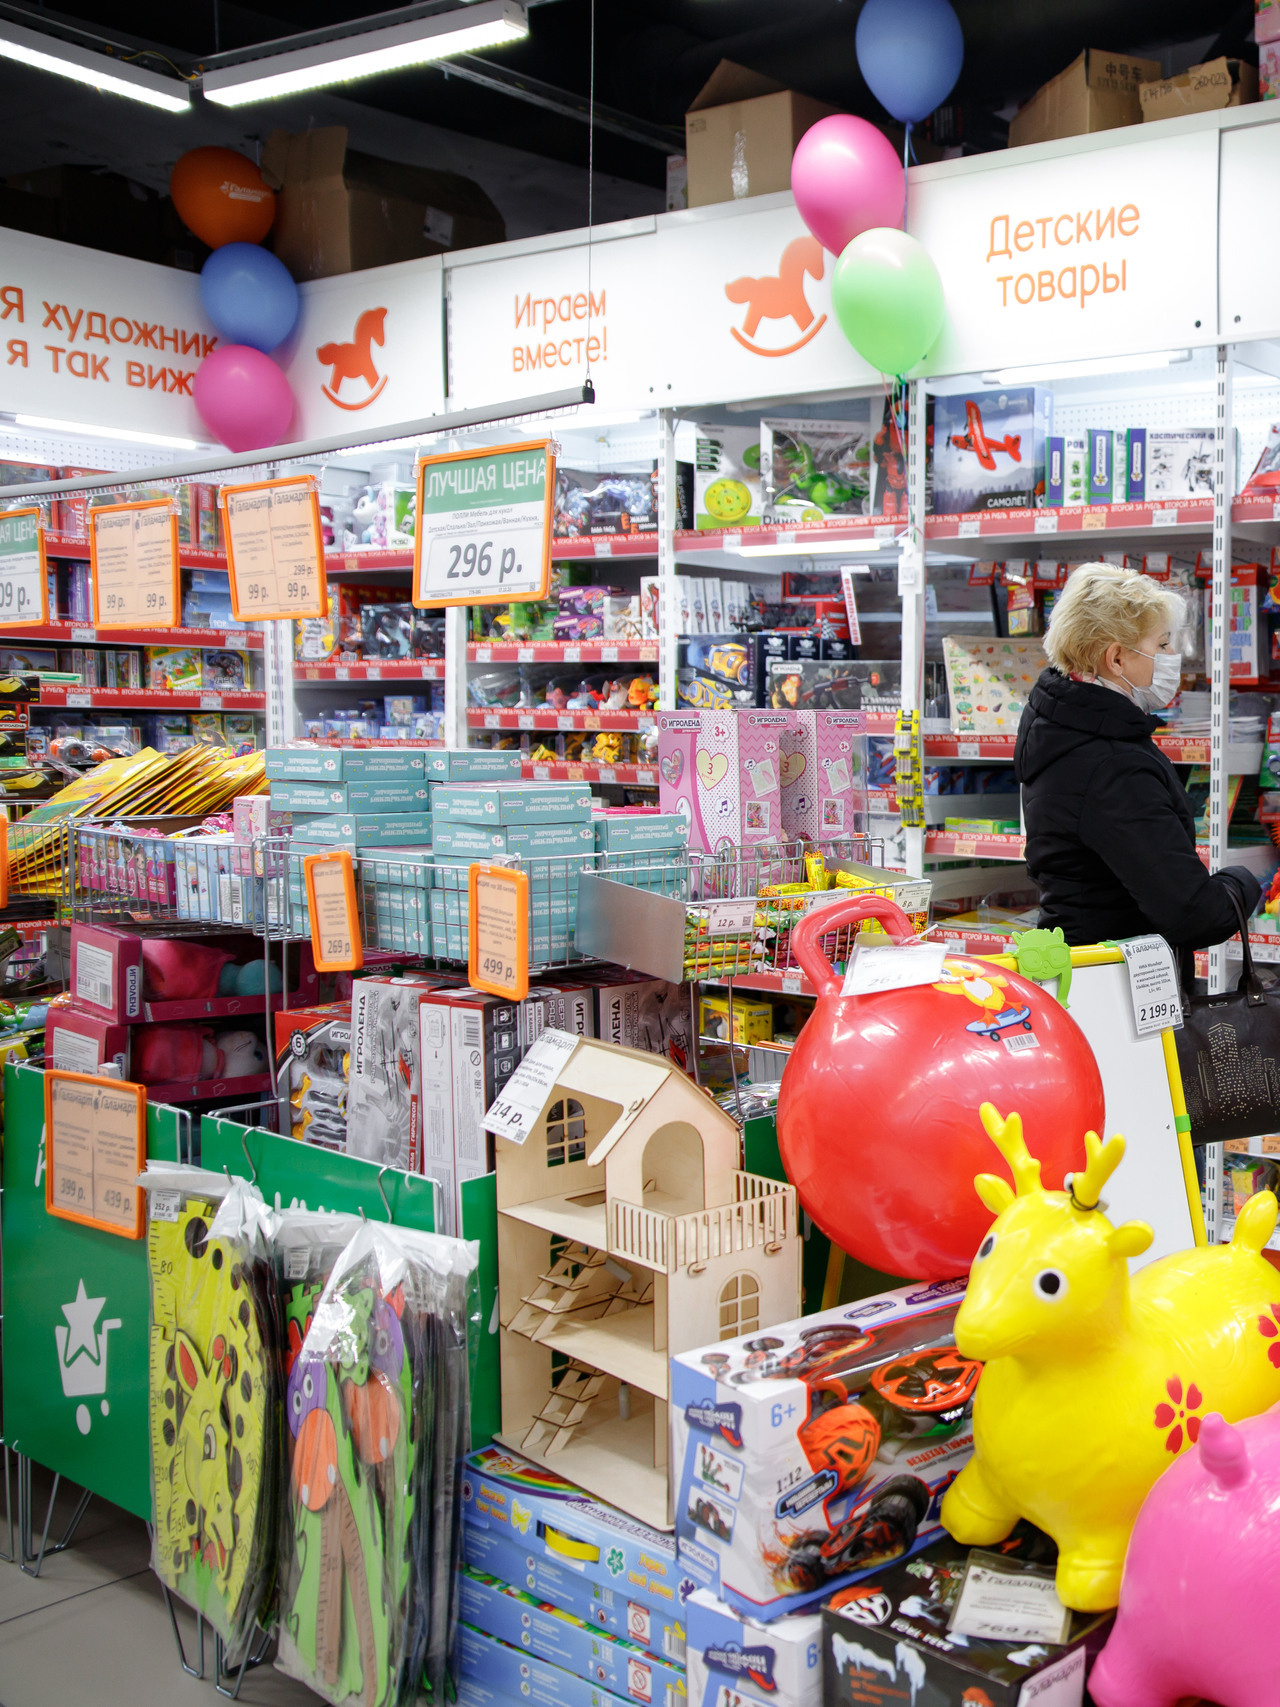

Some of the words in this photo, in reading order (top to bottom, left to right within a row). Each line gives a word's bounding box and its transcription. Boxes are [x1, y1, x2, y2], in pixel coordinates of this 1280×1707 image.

[987, 203, 1140, 262] Детские
[998, 258, 1127, 309] товары
[0, 286, 25, 323] Я
[514, 289, 606, 335] Играем
[513, 331, 608, 373] вместе!
[7, 338, 29, 368] я
[44, 345, 110, 383] так
[126, 360, 196, 397] виж
[427, 464, 496, 498] ЛУЧШАЯ
[503, 457, 546, 491] ЦЕНА
[987, 494, 1027, 508] САМОЛЁТ
[447, 541, 493, 579] 296
[499, 547, 522, 583] р.
[248, 584, 259, 599] 99
[288, 582, 298, 597] 99
[301, 585, 309, 600] р.
[106, 594, 116, 608] 99
[146, 593, 157, 608] 99
[159, 596, 167, 610] р.
[669, 719, 700, 728] ИГРОЛЕНД
[714, 725, 726, 737] 3+
[766, 743, 775, 751] 3+
[707, 763, 714, 775] 3
[718, 918, 727, 928] 12
[728, 918, 736, 929] р.
[327, 940, 342, 954] 269
[1132, 942, 1167, 954] Галамарт
[483, 957, 503, 976] 499
[505, 966, 515, 981] р.
[127, 967, 137, 1015] ИГРОЛЕНД
[1141, 1008, 1146, 1021] 2
[1149, 1003, 1167, 1019] 199
[1169, 1003, 1179, 1017] р.
[295, 1036, 303, 1049] 6
[356, 995, 366, 1075] ИГРОЛЕНД
[507, 1111, 523, 1126] р.
[60, 1177, 76, 1196] 399
[78, 1186, 86, 1203] р.
[104, 1189, 121, 1209] 439
[123, 1197, 133, 1215] р.
[155, 1202, 165, 1210] 252
[160, 1261, 173, 1275] 80
[770, 1403, 796, 1428] 6+
[776, 1467, 803, 1494] 1:12
